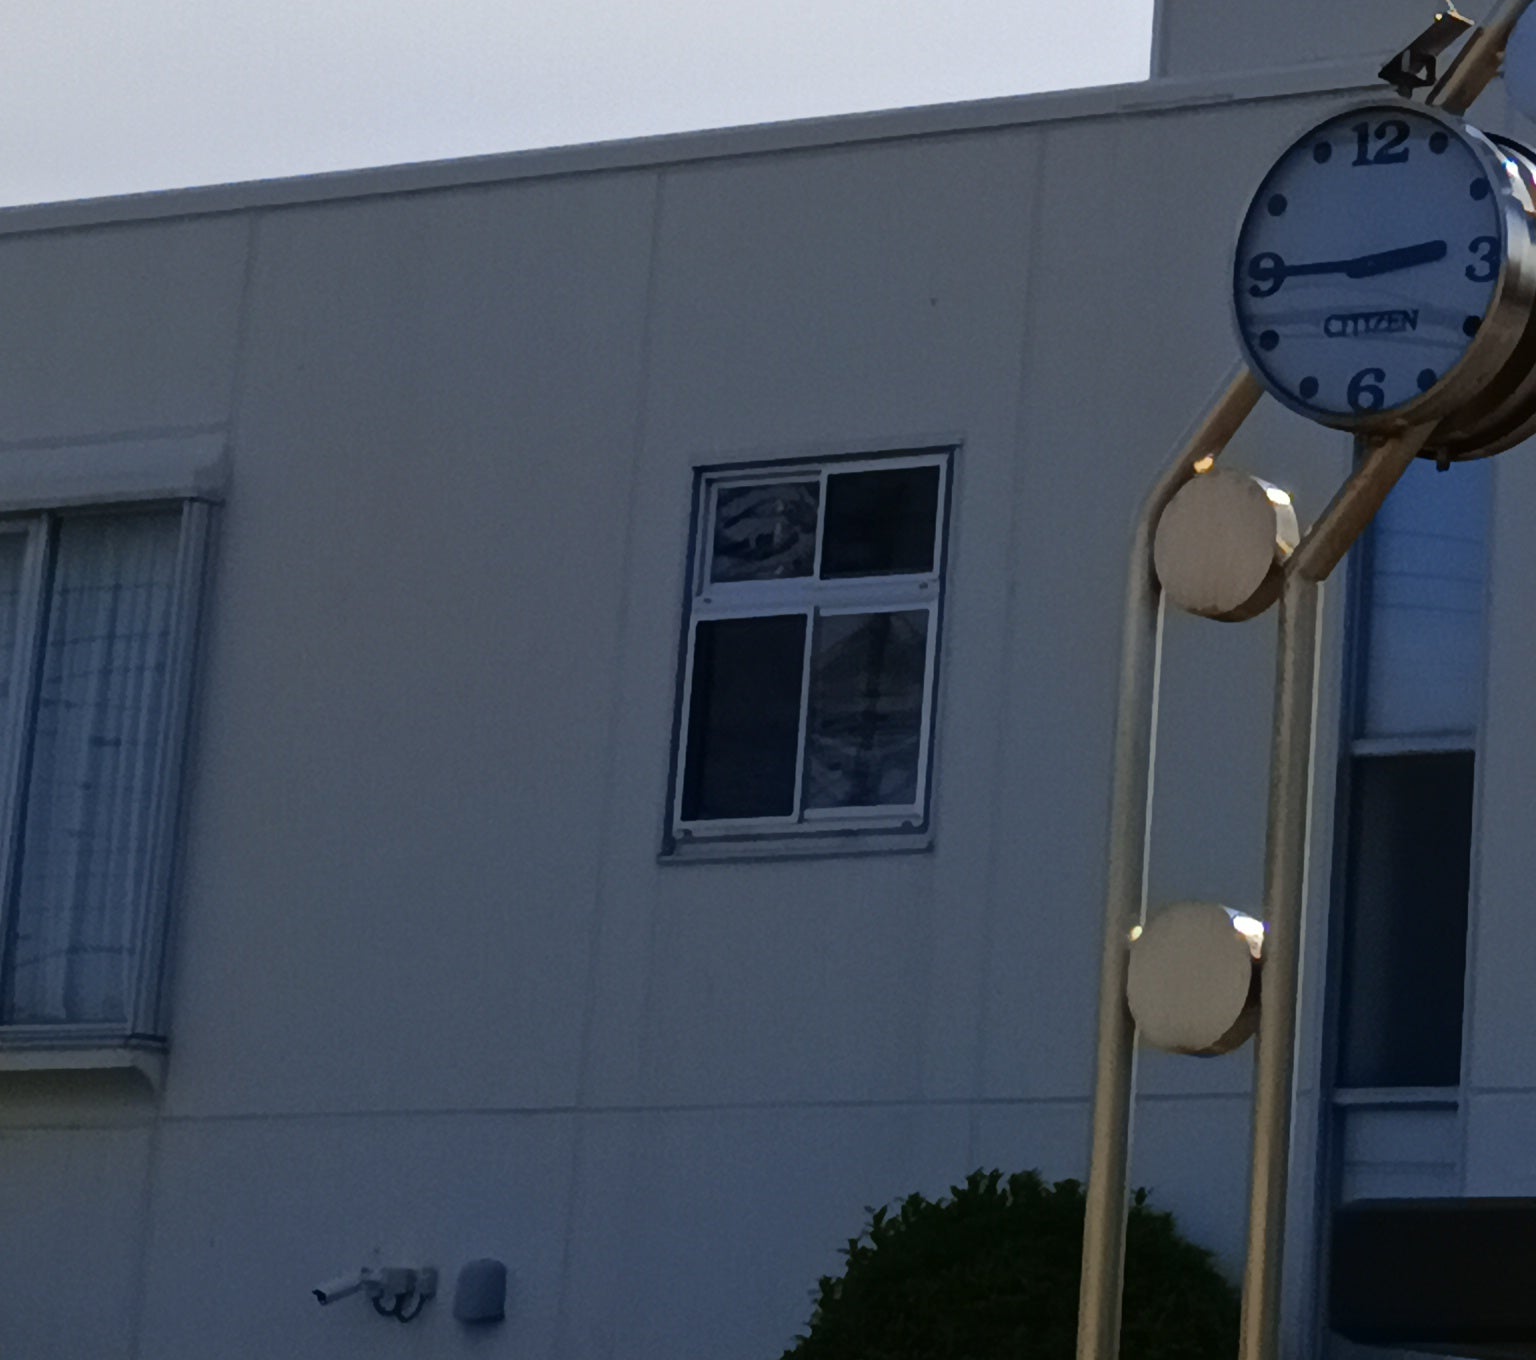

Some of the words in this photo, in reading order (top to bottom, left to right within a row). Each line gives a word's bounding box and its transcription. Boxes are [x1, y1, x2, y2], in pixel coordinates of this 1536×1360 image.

[1350, 120, 1411, 167] 12
[1248, 252, 1287, 298] 9
[1464, 236, 1501, 282] 3
[1323, 310, 1418, 338] CITIZEN
[1346, 367, 1387, 412] 6
